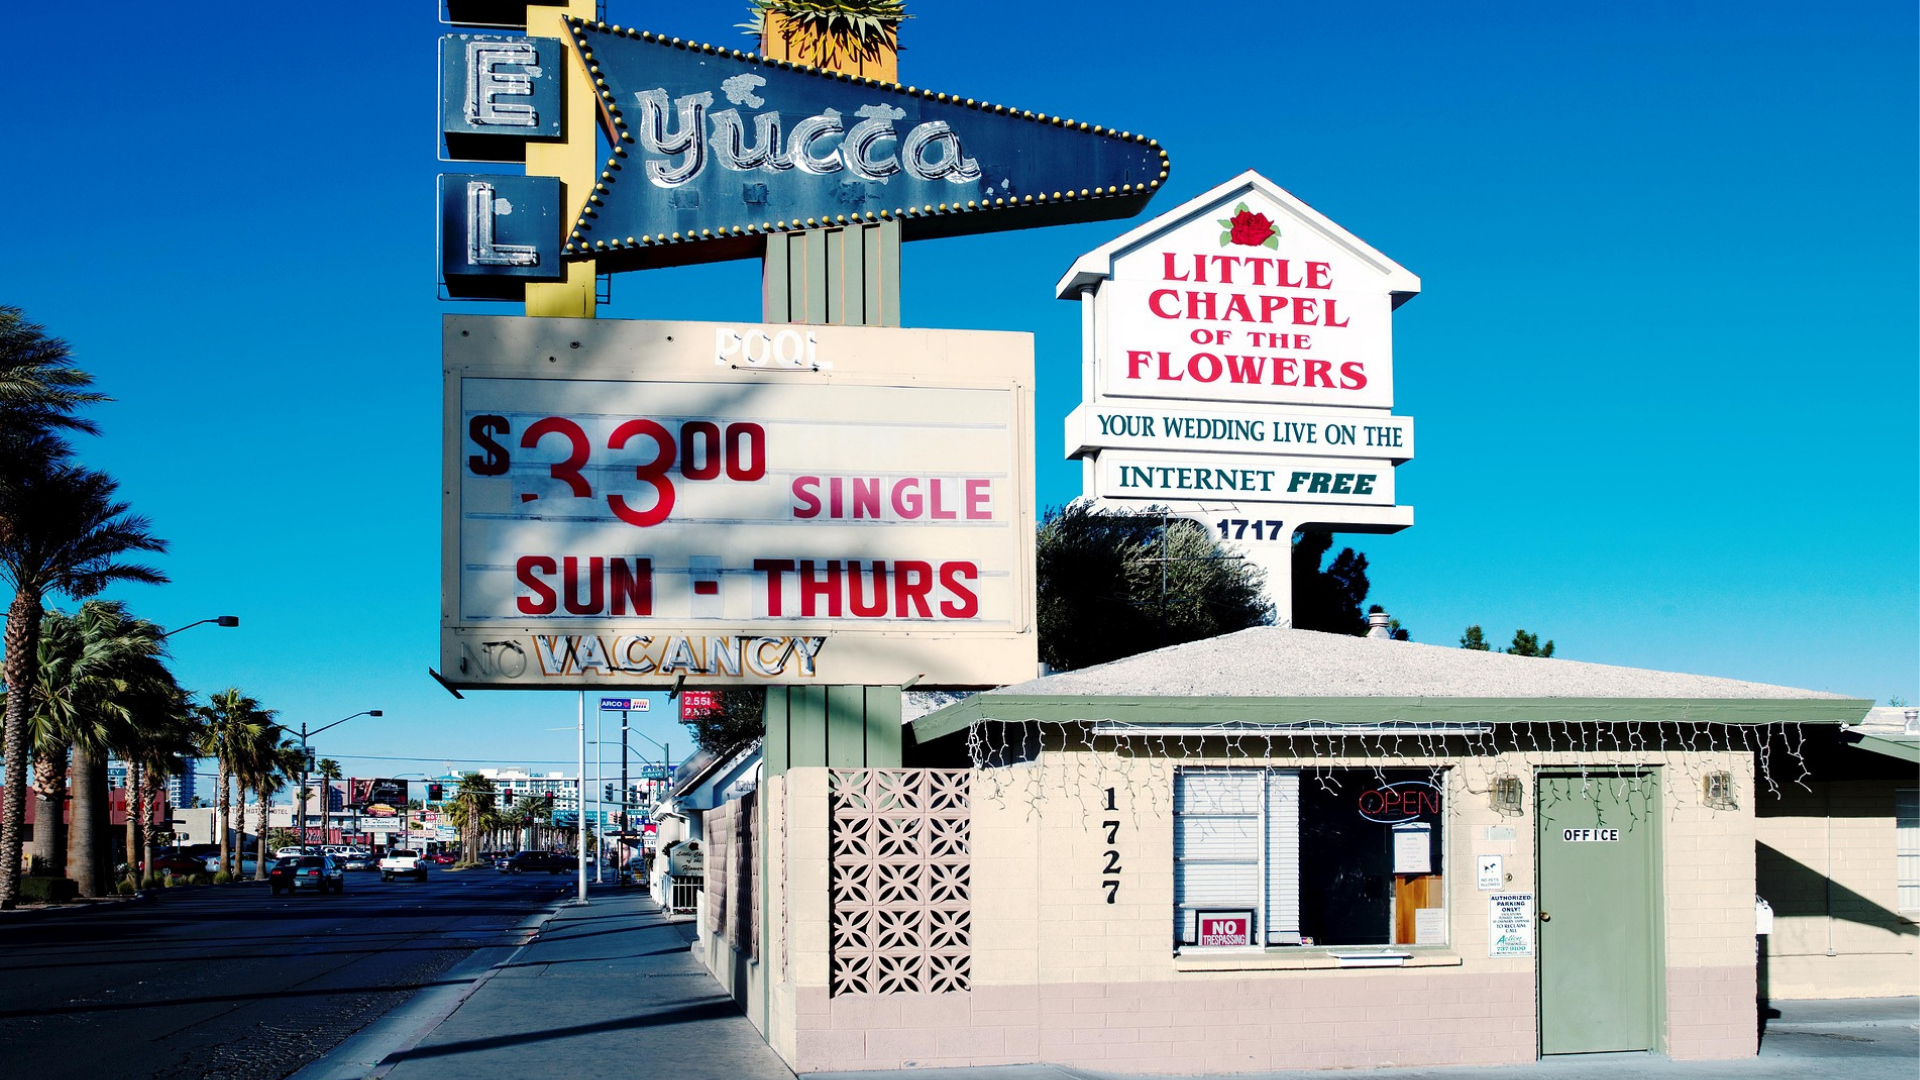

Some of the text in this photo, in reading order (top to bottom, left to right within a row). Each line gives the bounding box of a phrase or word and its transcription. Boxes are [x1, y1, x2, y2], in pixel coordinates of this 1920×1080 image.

[1162, 252, 1333, 290] LITTLE
[1148, 289, 1350, 328] CHAPEL
[715, 327, 833, 369] POOL
[1190, 328, 1312, 350] OF THE
[1126, 350, 1368, 391] FLOWERS
[1098, 414, 1403, 448] YOUR WEDDING LIVE ON THE
[791, 475, 993, 520] SINGLE
[1119, 466, 1377, 495] INTERNET FREE
[1216, 518, 1284, 541] 1717
[517, 555, 653, 616] SUN
[753, 558, 979, 619] THURS
[532, 635, 827, 677] VACANCY
[1358, 790, 1439, 815] OPEN
[1101, 787, 1122, 904] 1727
[1563, 829, 1618, 842] OFFICE
[1202, 934, 1246, 946] TRESPASSING
[1212, 920, 1237, 936] NO
